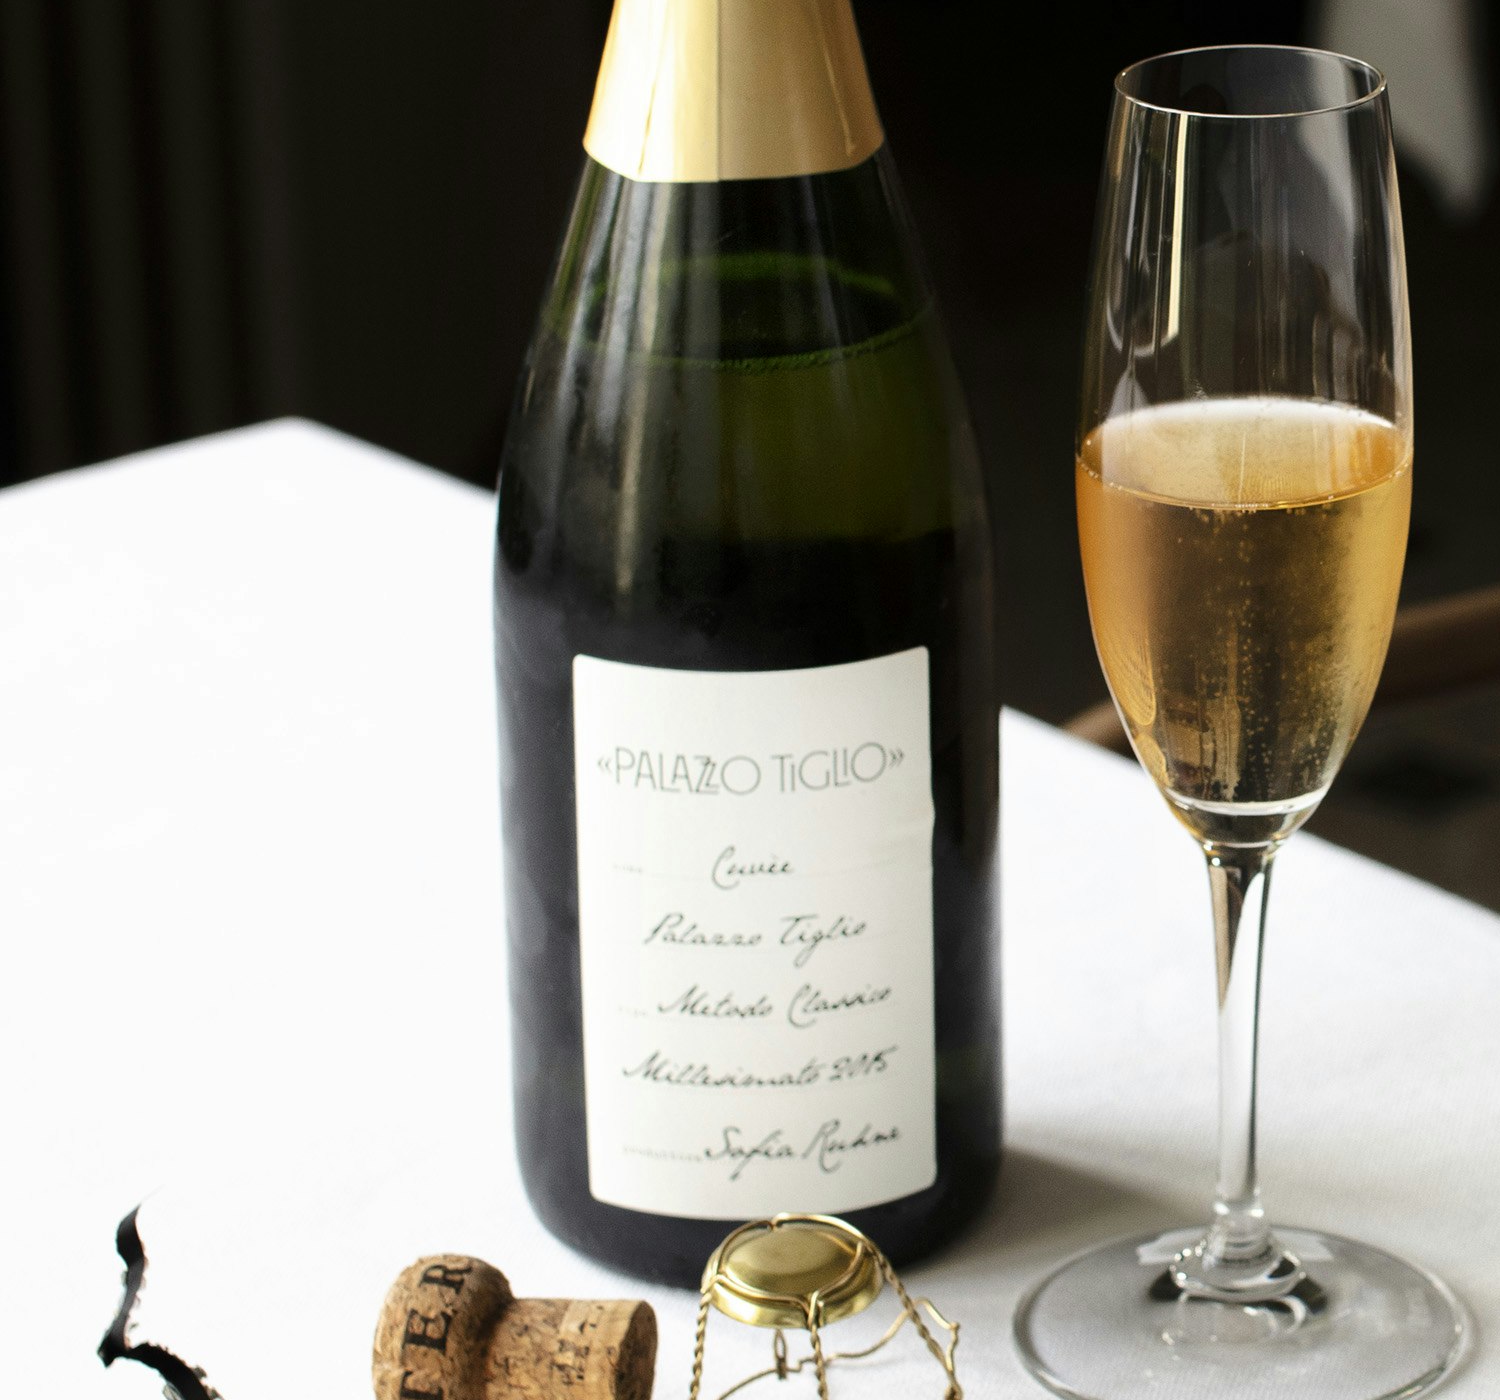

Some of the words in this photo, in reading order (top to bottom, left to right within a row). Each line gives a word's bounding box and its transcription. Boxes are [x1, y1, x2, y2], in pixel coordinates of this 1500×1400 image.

[644, 912, 762, 947] Palazzo
[779, 913, 867, 969] Tiglio
[656, 983, 774, 1018] Metodo
[787, 982, 892, 1029] Classico
[827, 1045, 899, 1083] 2015
[704, 1125, 794, 1182] Sofia
